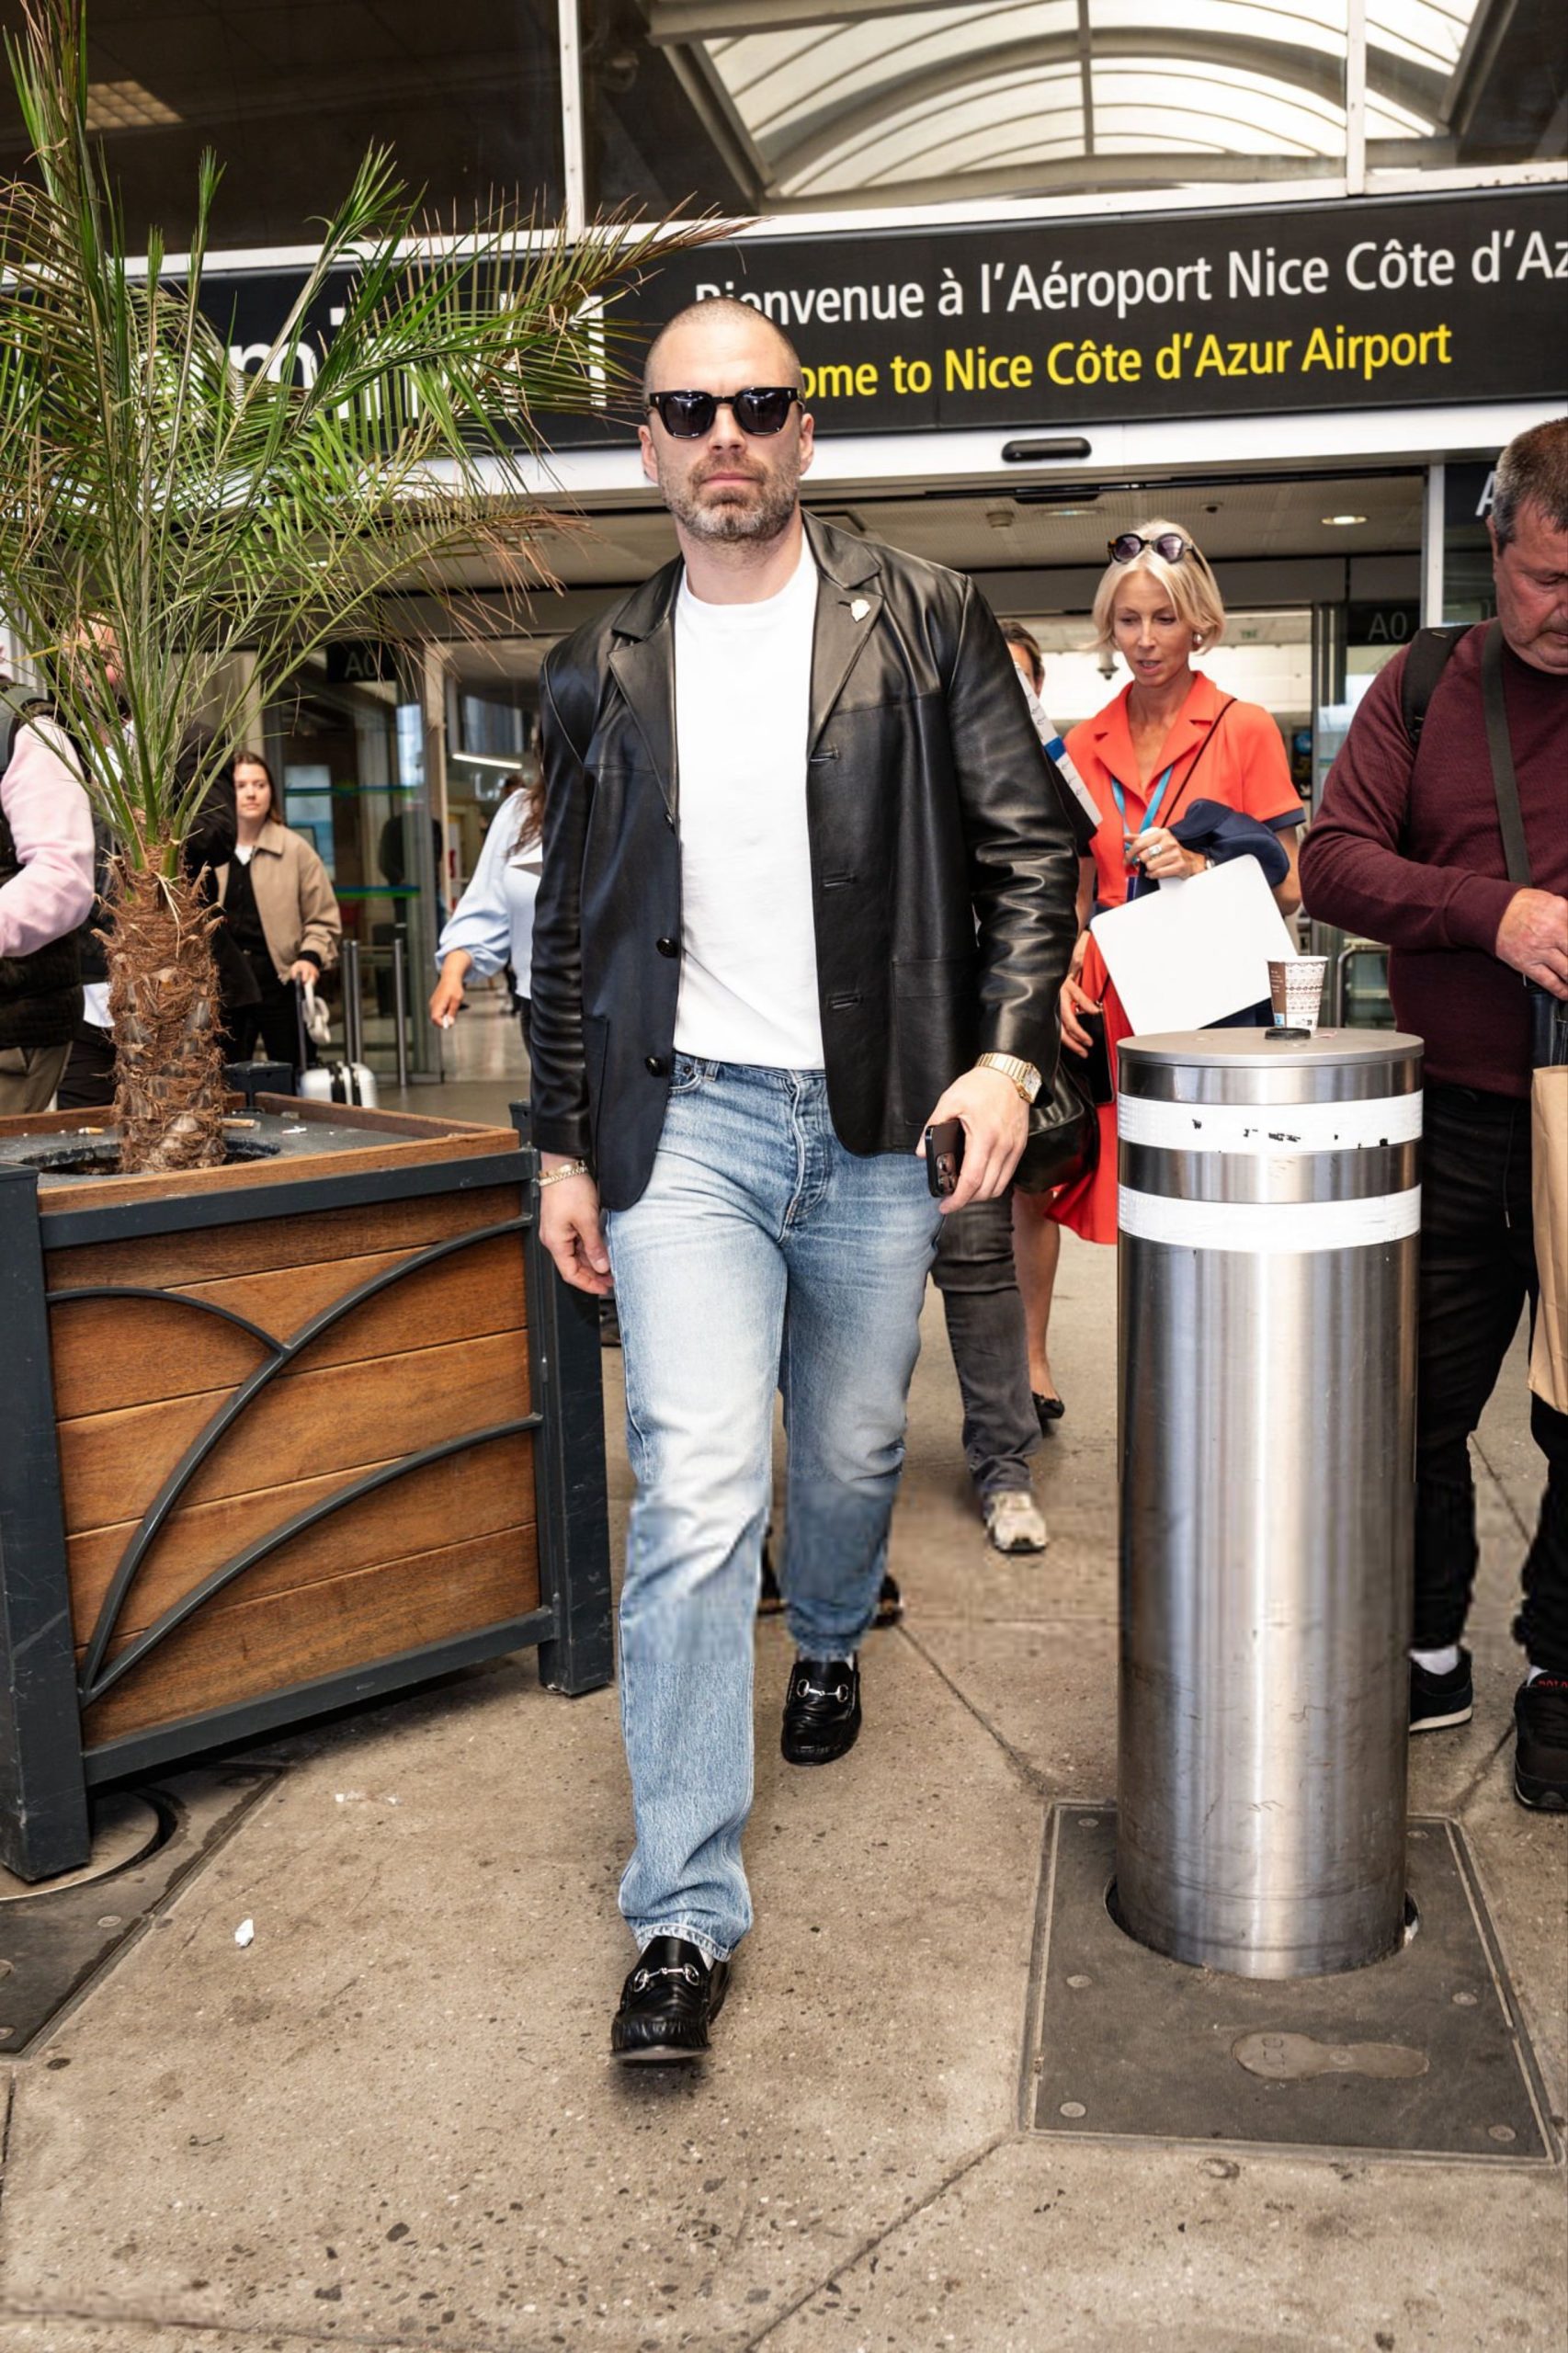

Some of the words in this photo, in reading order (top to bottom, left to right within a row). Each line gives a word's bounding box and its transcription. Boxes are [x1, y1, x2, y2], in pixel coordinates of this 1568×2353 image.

[937, 267, 963, 316] à
[980, 257, 1212, 319] l'Aéroport
[1229, 247, 1329, 299] Nice
[1346, 238, 1455, 290] Côte
[890, 355, 932, 394] to
[945, 346, 1033, 392] Nice
[1047, 339, 1142, 385] Côte
[1155, 332, 1293, 381] d'Azur
[1301, 324, 1452, 381] Airport
